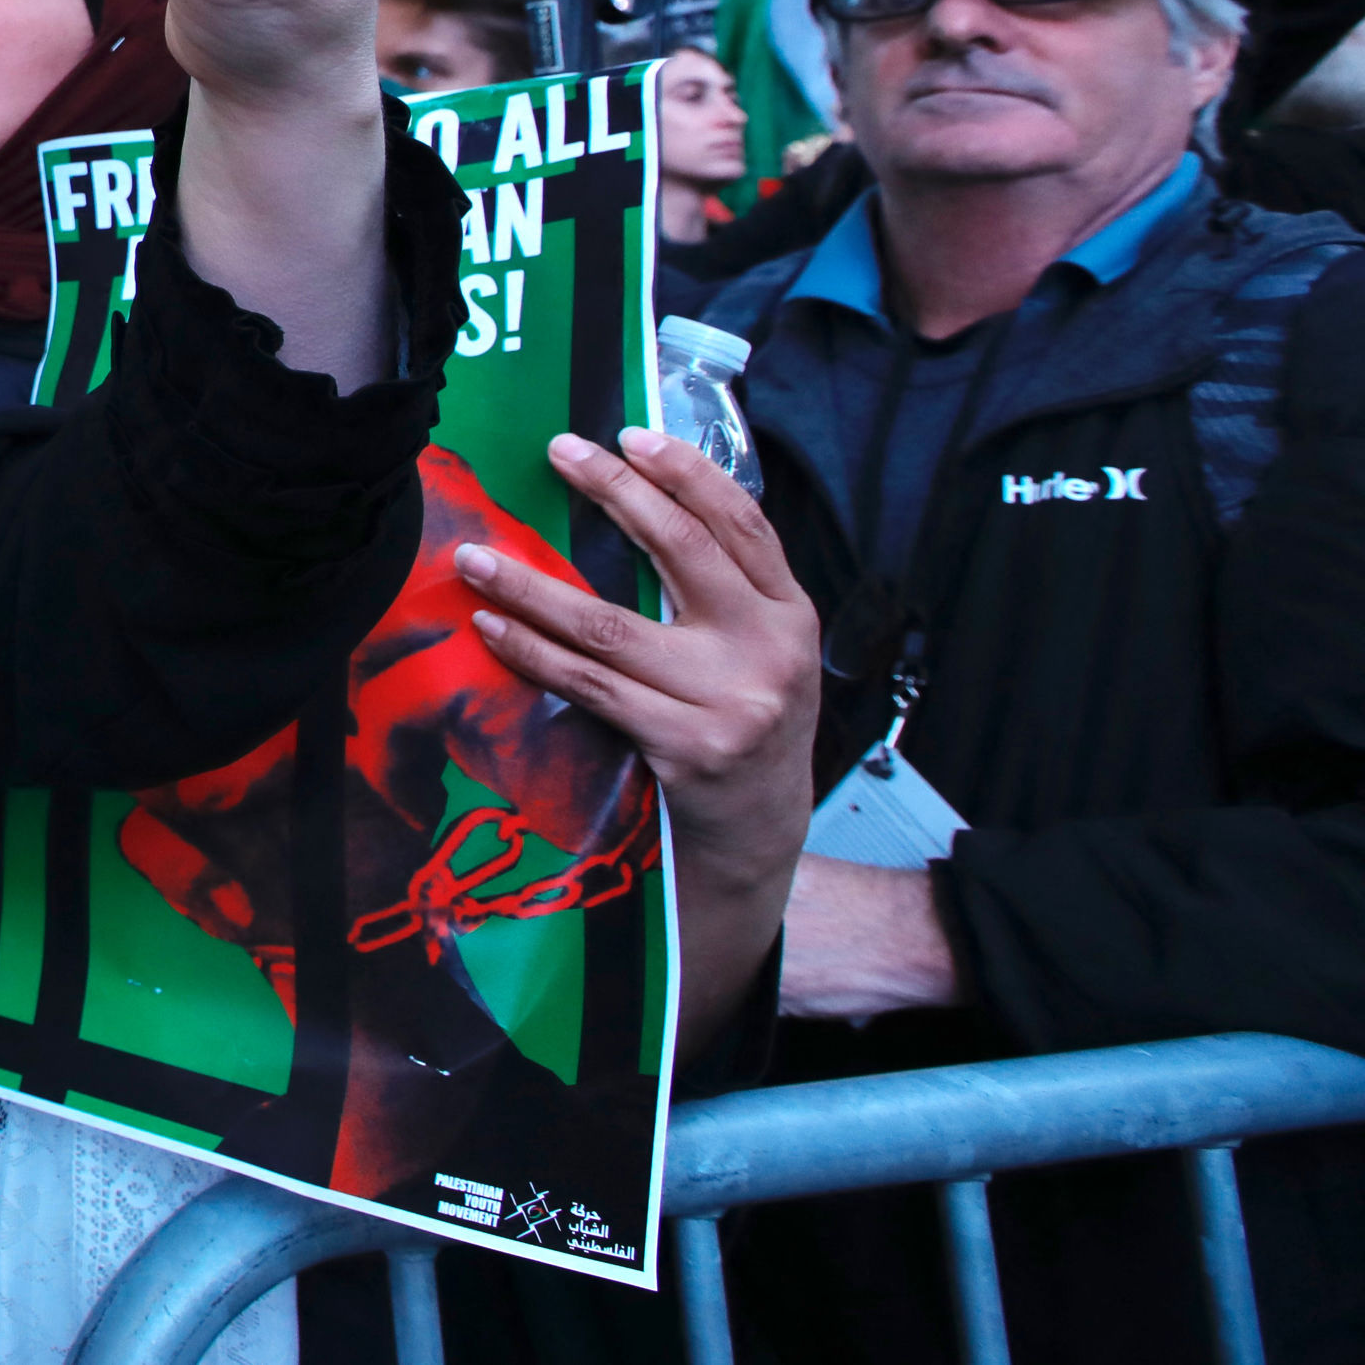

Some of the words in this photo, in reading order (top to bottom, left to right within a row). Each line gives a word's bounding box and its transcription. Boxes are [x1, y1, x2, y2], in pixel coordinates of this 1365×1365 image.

[52, 155, 157, 232] FR
[491, 75, 632, 174] ALL
[434, 1172, 505, 1202] PALESTINIAN
[436, 1200, 501, 1228] MOVEMENT
[463, 1193, 502, 1215] YOUTH
[569, 1201, 602, 1223] حركة
[568, 1219, 611, 1240] الشباب
[566, 1237, 637, 1262] الفلسطيني
